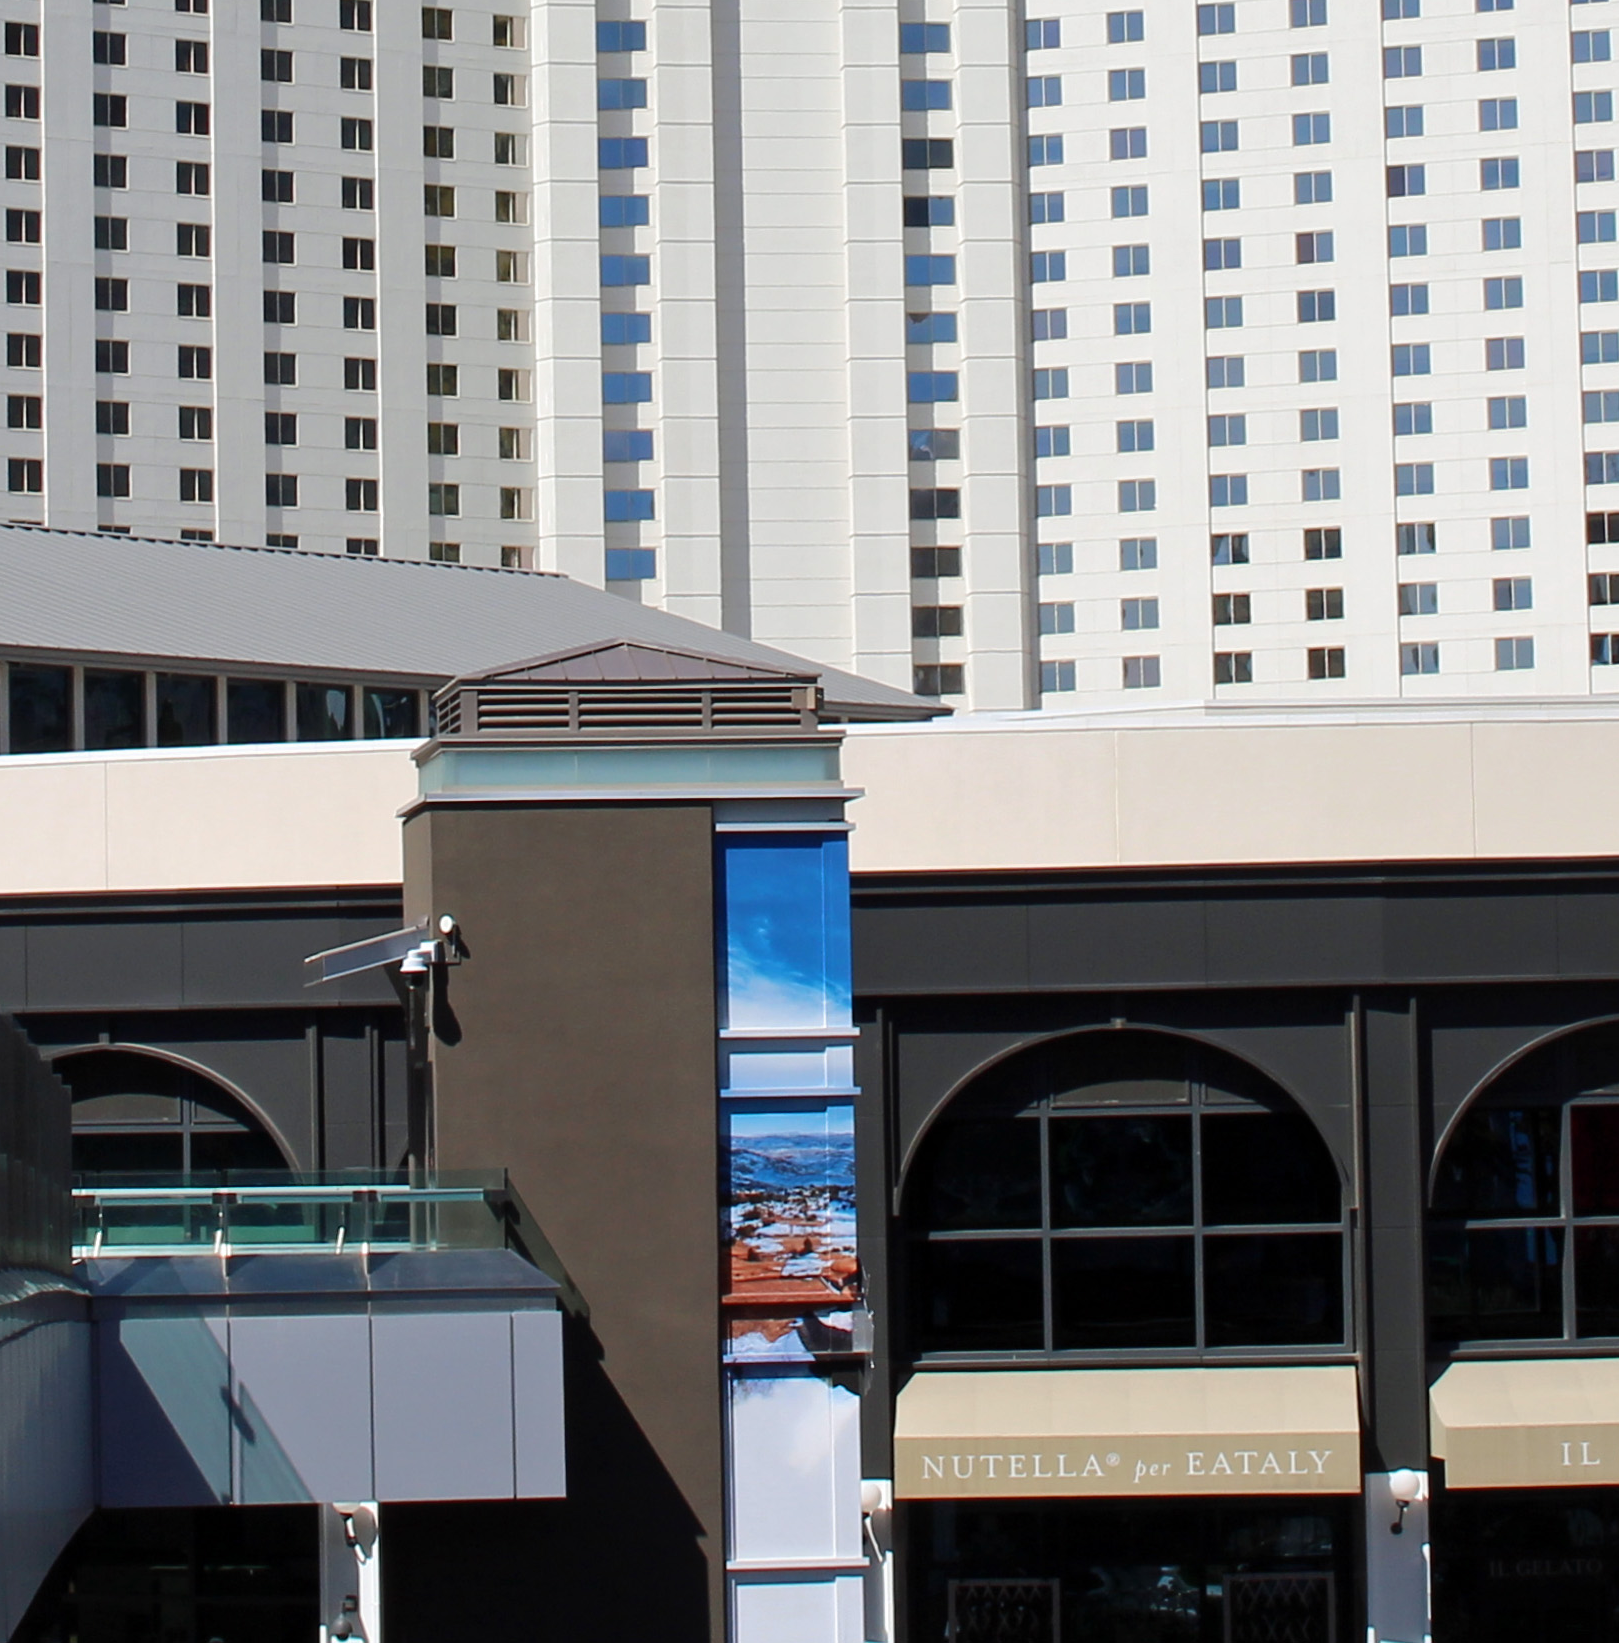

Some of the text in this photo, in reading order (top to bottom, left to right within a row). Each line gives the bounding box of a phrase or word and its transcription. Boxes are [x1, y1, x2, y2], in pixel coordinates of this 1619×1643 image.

[1133, 1457, 1172, 1484] per
[1185, 1449, 1334, 1477] EATALY
[1561, 1441, 1601, 1467] IL
